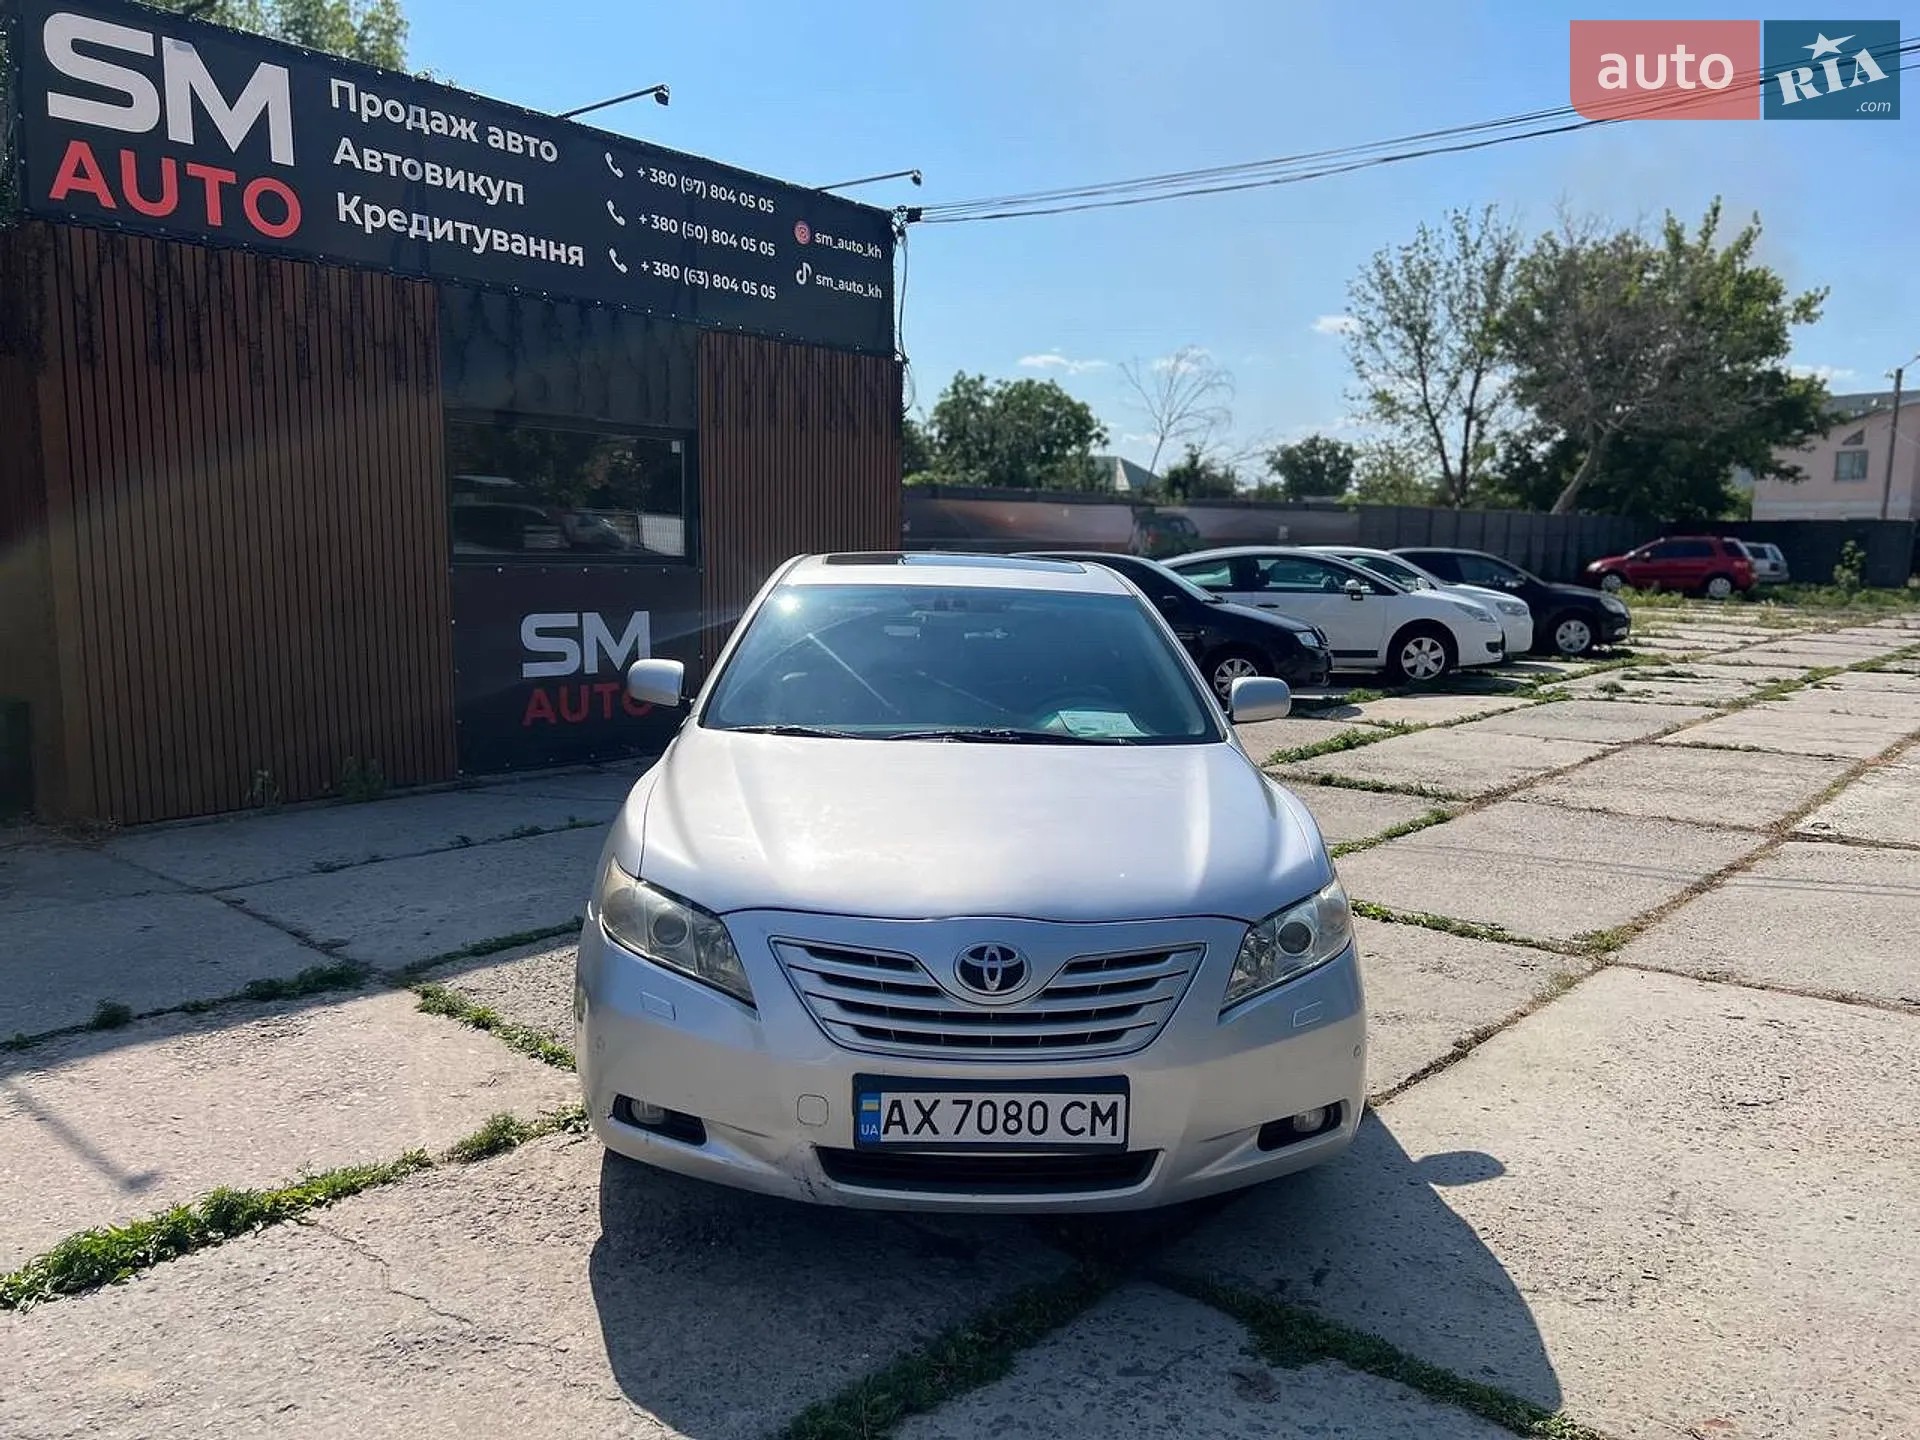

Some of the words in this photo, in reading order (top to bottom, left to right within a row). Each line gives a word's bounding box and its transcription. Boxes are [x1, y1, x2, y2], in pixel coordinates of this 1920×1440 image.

[43, 12, 295, 167] SM
[330, 78, 479, 144] Продаж
[486, 125, 559, 164] авто
[48, 139, 301, 240] AUTO
[332, 137, 525, 206] Автовикуп
[649, 167, 677, 188] 380
[681, 175, 706, 199] (97)
[710, 184, 736, 204] 804
[739, 193, 756, 209] 05
[758, 196, 775, 213] 05
[336, 192, 586, 268] Кредитування
[650, 213, 678, 234] 380
[682, 221, 708, 245] (50)
[712, 230, 738, 250] 804
[740, 238, 758, 254] 05
[760, 241, 776, 258] 05
[814, 231, 882, 259] sm_auto_kh
[652, 260, 680, 280] 380
[684, 268, 709, 292] (63)
[713, 274, 739, 294] 804
[742, 282, 759, 298] 05
[761, 284, 778, 300] 05
[815, 271, 883, 299] sm_auto_kh
[520, 610, 651, 678] SM
[861, 1124, 878, 1136] UA
[882, 1099, 940, 1135] AX
[952, 1100, 1048, 1135] 7080
[1060, 1101, 1117, 1136] CM
